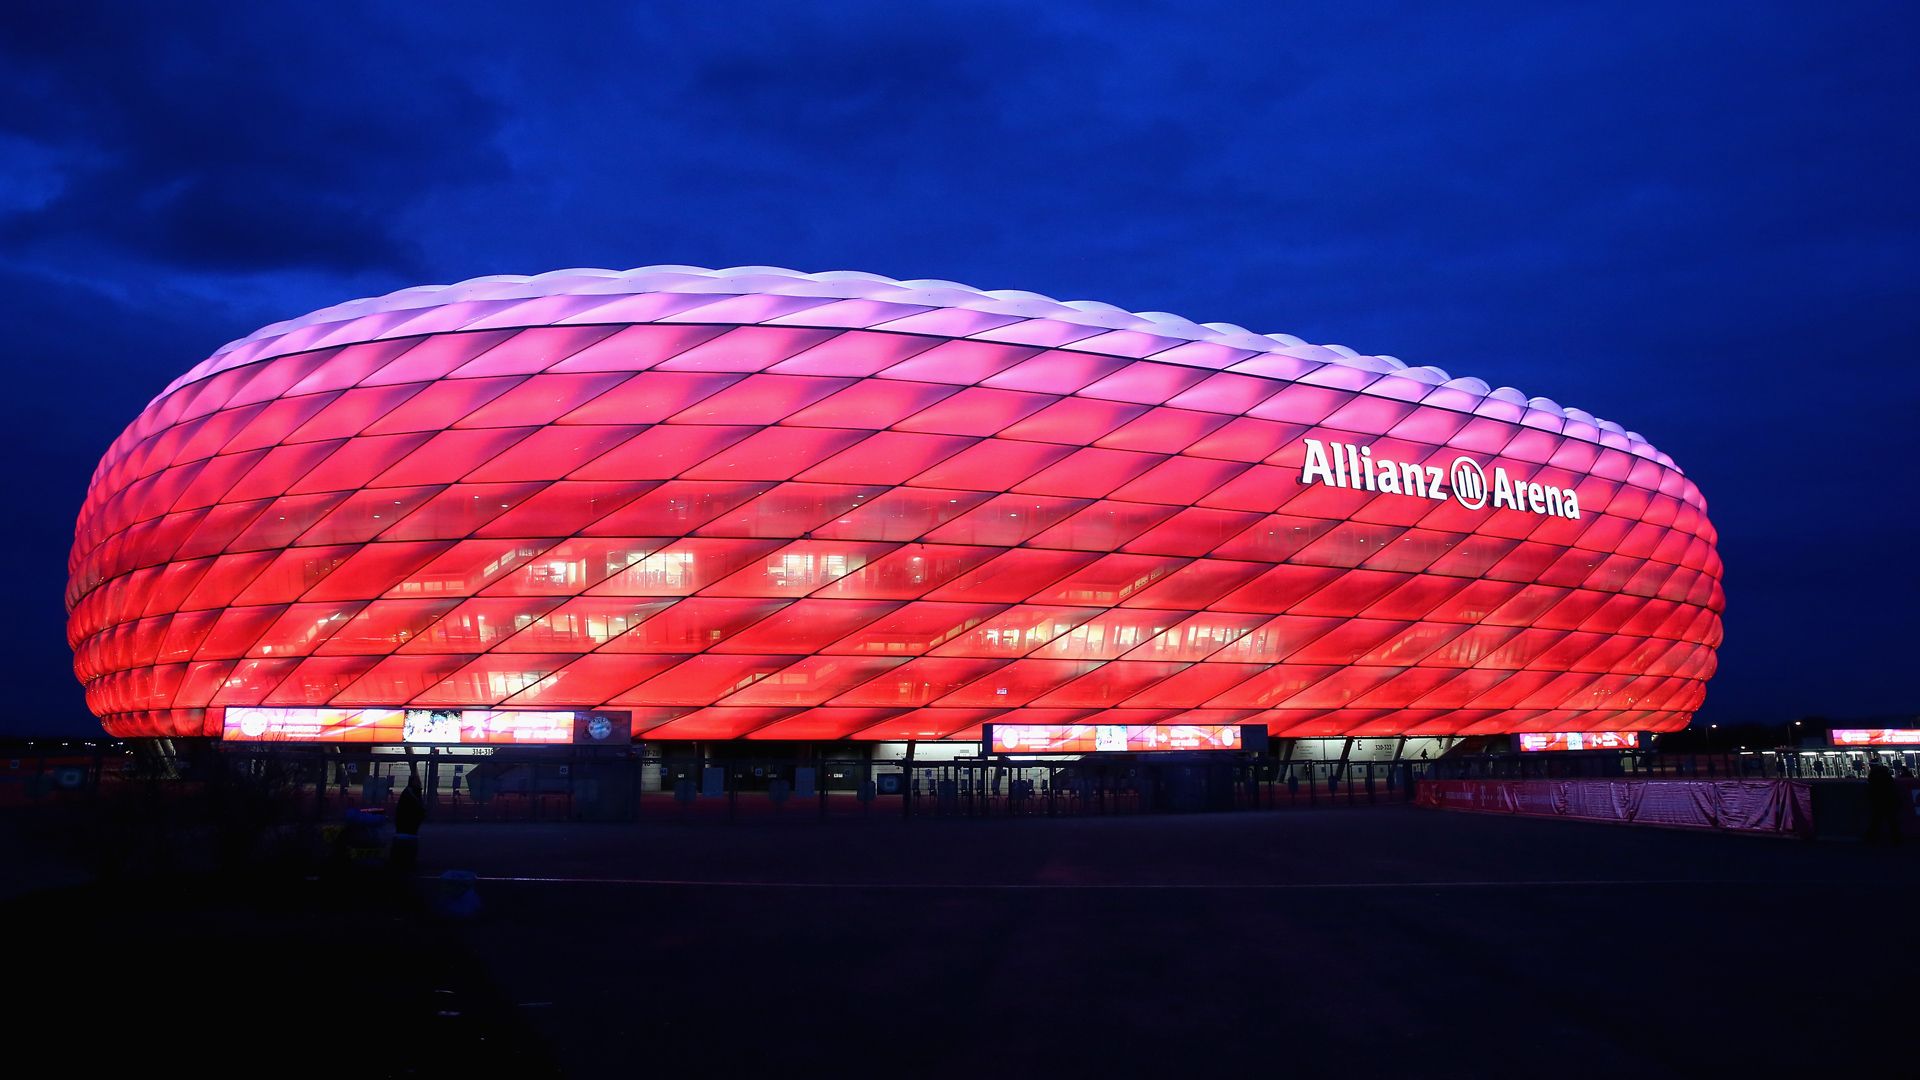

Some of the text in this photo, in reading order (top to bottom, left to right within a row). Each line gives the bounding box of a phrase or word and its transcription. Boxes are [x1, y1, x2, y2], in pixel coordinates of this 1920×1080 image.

[1302, 438, 1580, 520] Allianz Arena
[1357, 739, 1362, 751] E
